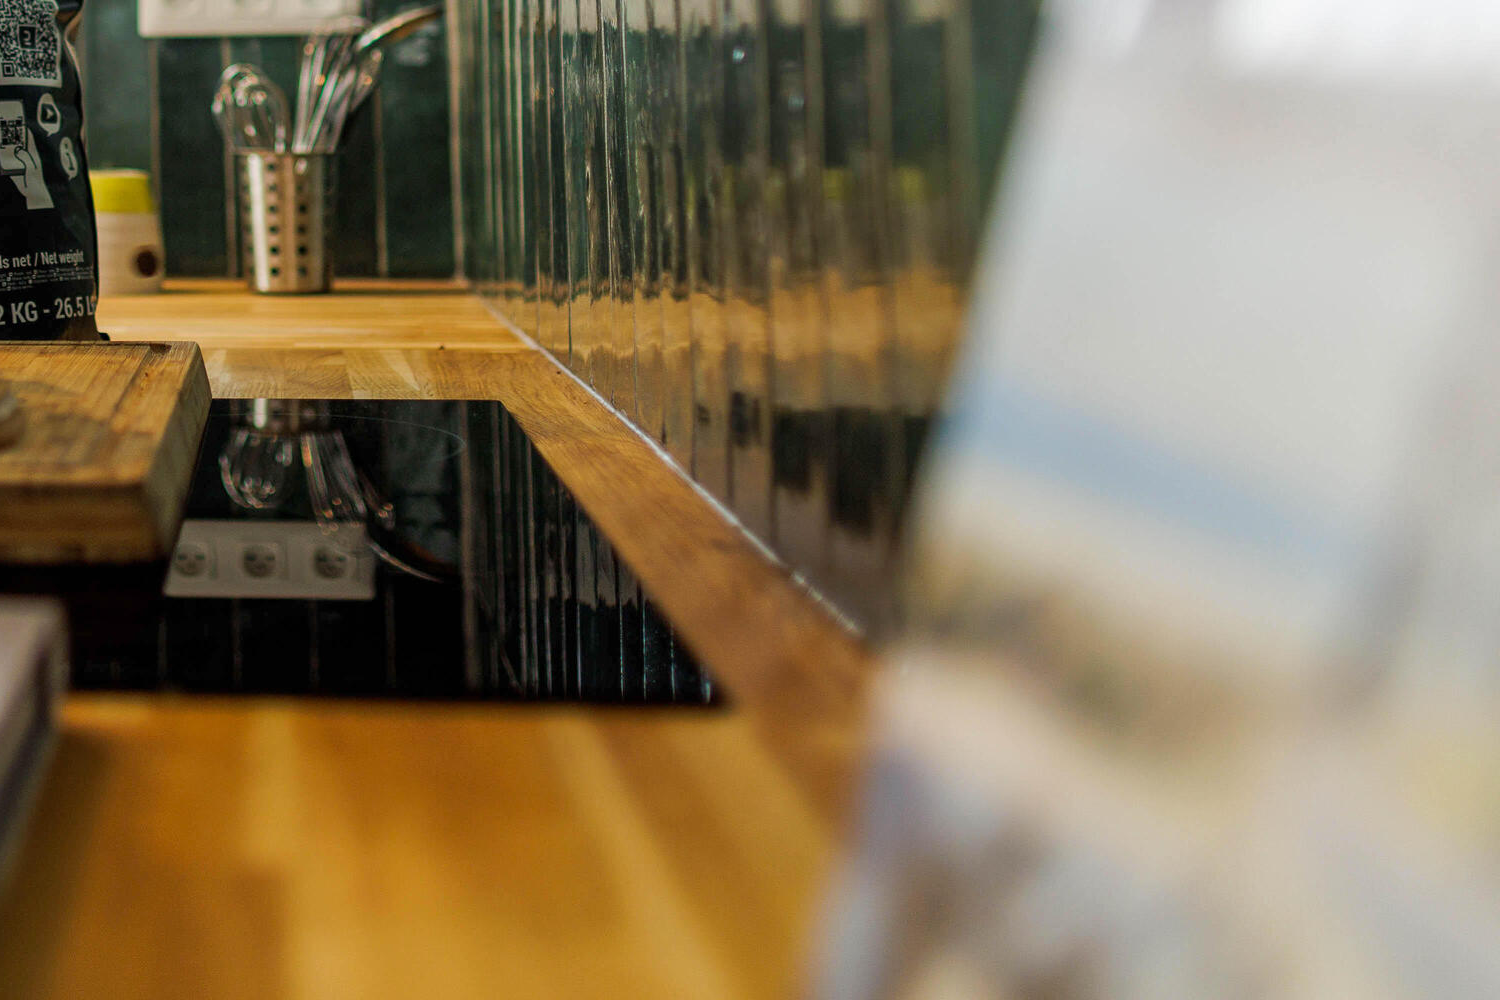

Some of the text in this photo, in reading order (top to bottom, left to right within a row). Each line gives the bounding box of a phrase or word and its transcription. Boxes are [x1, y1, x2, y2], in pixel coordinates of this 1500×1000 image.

[12, 254, 32, 268] net
[34, 252, 39, 268] /
[40, 251, 58, 265] Net
[59, 249, 85, 267] weight
[11, 301, 39, 325] KG
[54, 296, 85, 320] 26.5
